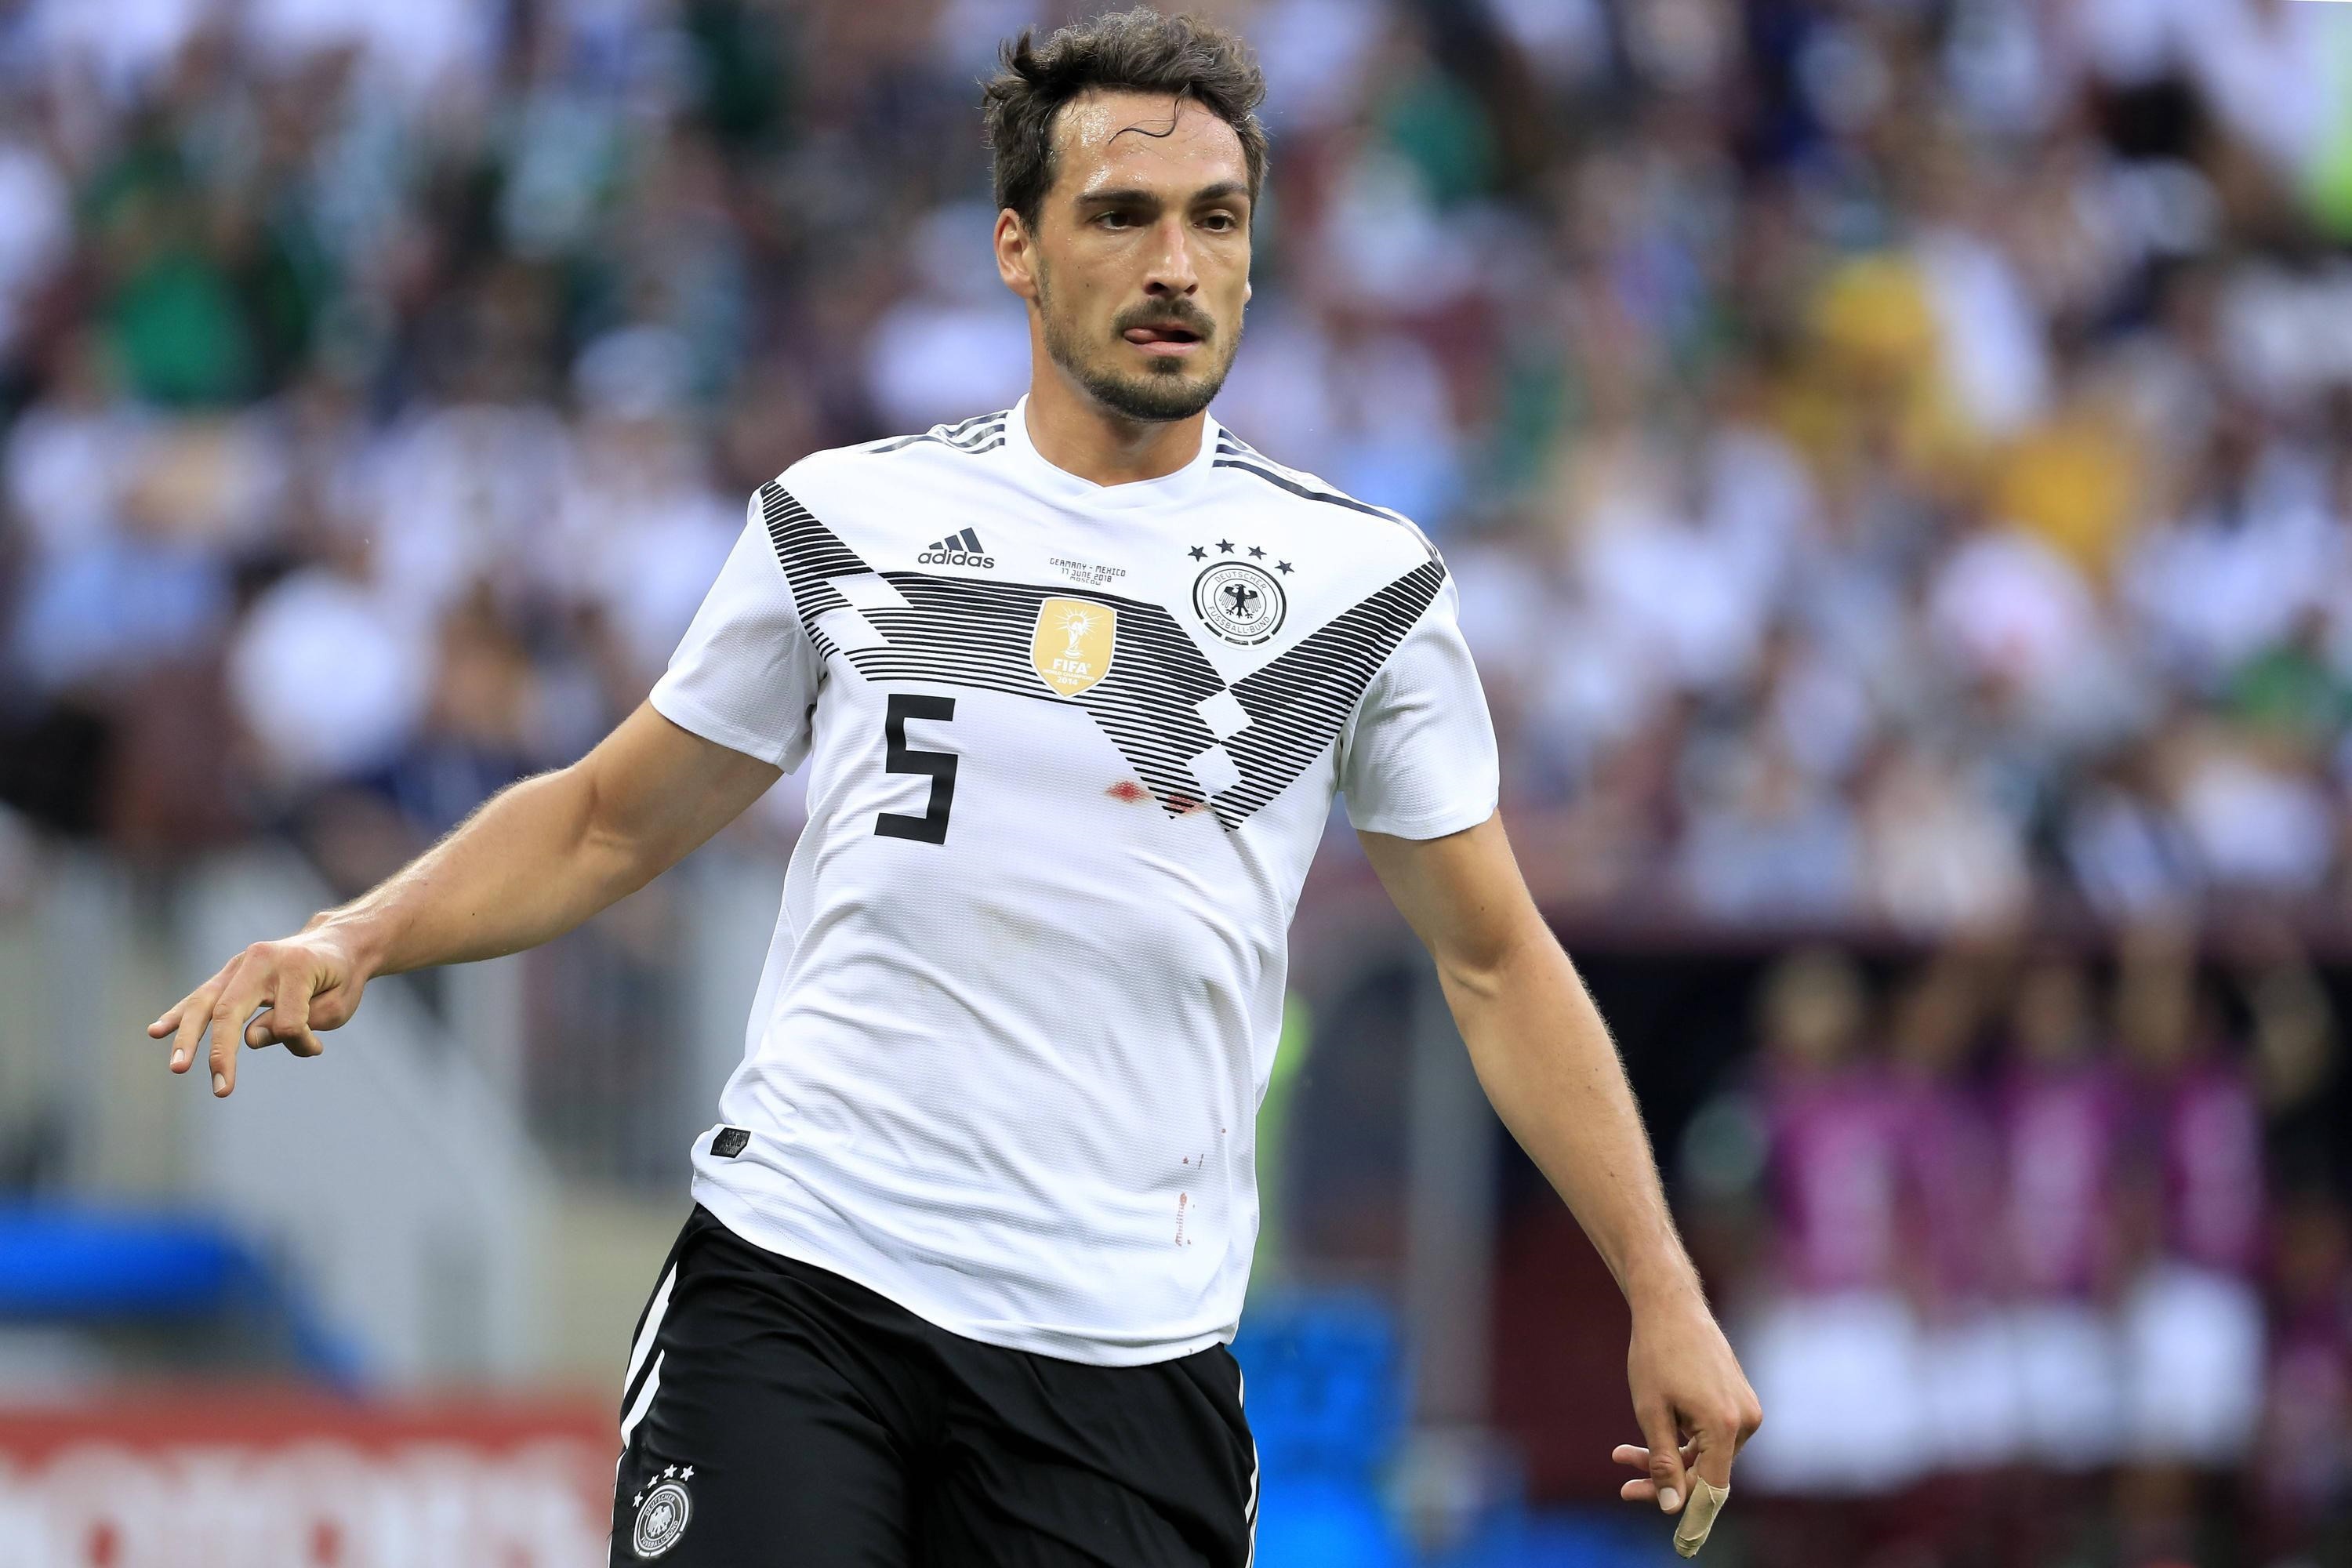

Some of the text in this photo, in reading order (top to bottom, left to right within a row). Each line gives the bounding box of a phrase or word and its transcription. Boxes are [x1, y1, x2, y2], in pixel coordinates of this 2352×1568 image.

[918, 549, 995, 569] adidas
[1050, 558, 1087, 570] GERMANY
[1095, 566, 1126, 576] MEXICO
[1070, 576, 1101, 585] MOSCOW
[1071, 569, 1091, 579] JUNE
[1094, 573, 1112, 583] 2018
[1214, 571, 1267, 590] DEUTSCHER
[1208, 605, 1270, 633] FUSSBALL-BUND
[1053, 659, 1087, 674] FIFA
[1056, 676, 1078, 685] 2014
[874, 693, 958, 845] 5
[644, 1494, 676, 1516] DEUTSCHER
